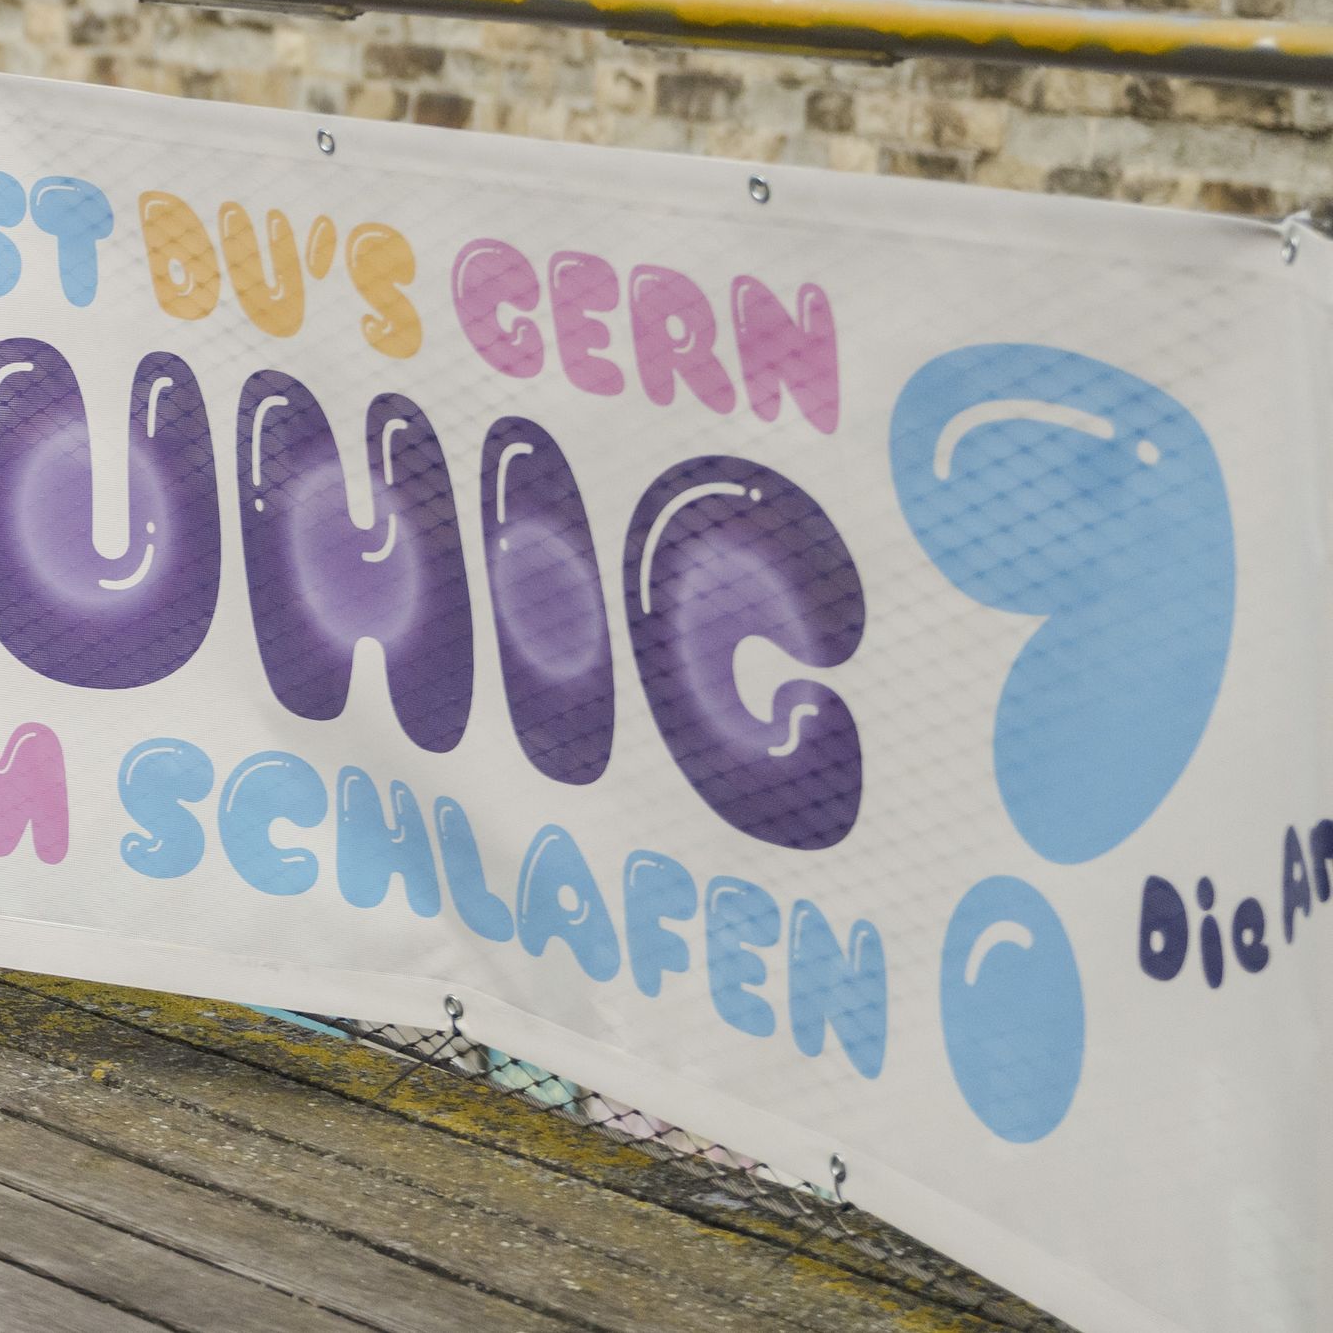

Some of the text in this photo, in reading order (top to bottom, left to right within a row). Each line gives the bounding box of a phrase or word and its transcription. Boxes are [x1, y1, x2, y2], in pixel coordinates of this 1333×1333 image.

[137, 189, 424, 359] DU'S
[451, 237, 841, 435] GERN
[117, 736, 889, 1080] SCHLAFEN
[1139, 874, 1271, 990] Die
